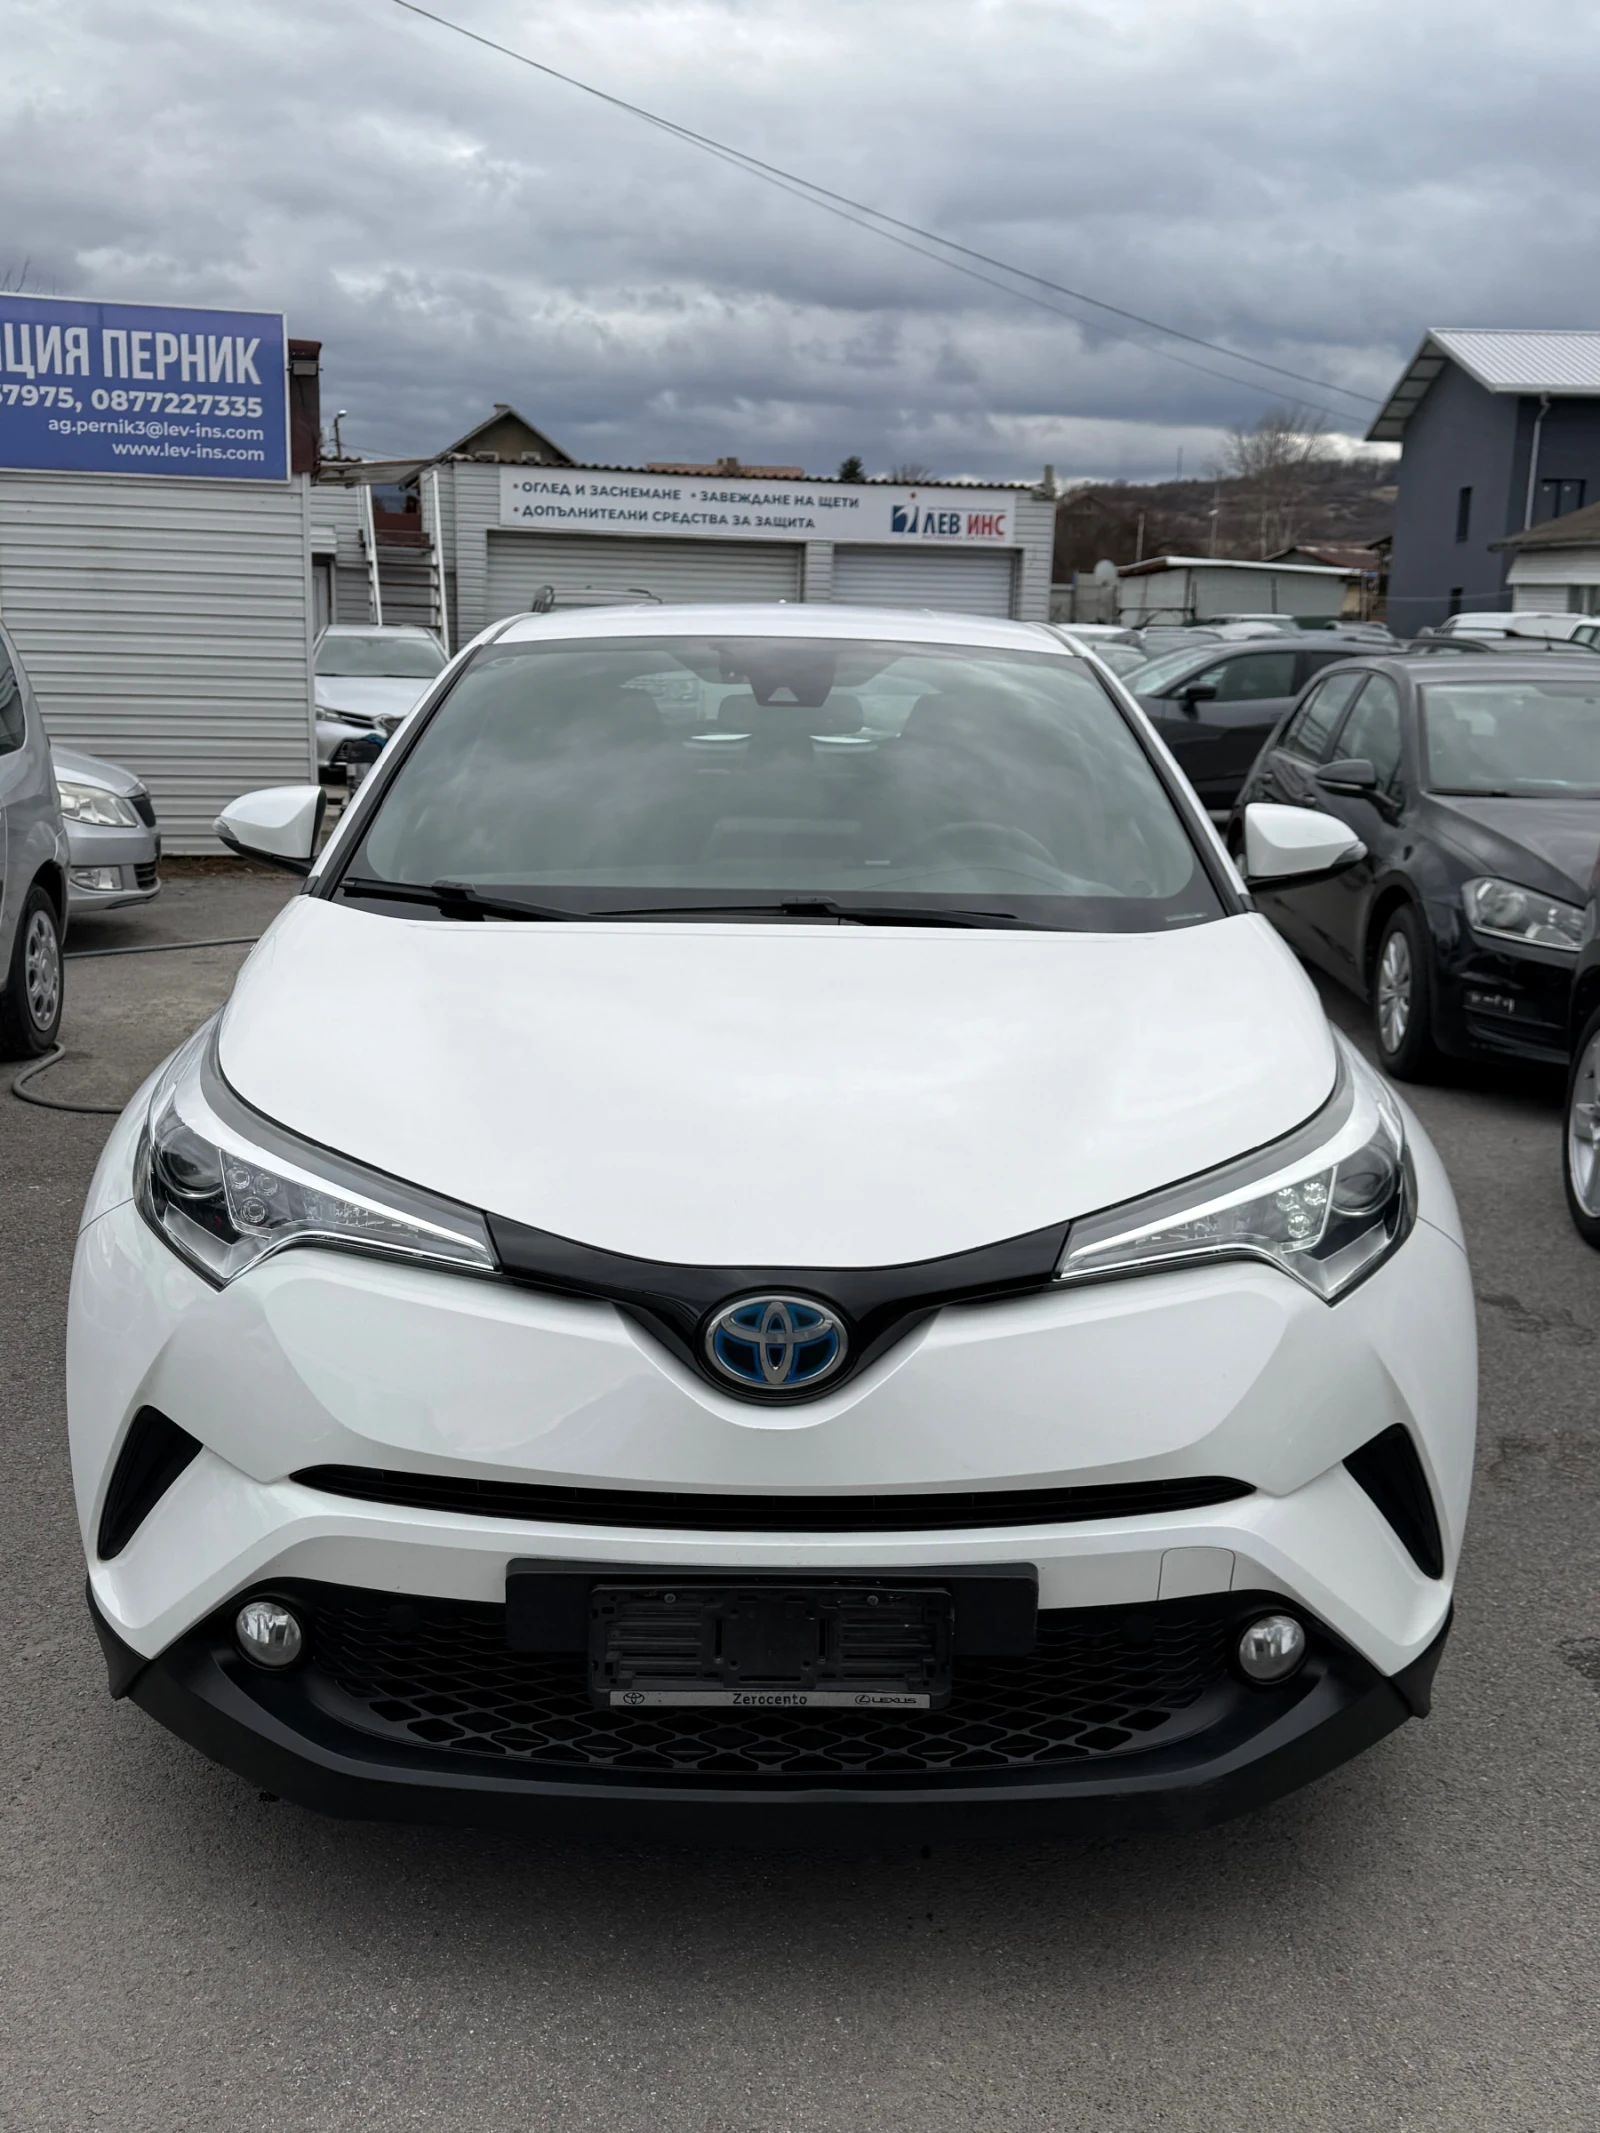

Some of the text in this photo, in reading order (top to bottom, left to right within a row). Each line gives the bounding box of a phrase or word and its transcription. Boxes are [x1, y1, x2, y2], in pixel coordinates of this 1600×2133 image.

[0, 322, 262, 385] ЦИЯ ПЕРНИК
[0, 383, 263, 418] 7975, 0877227335
[48, 418, 264, 440] ag.pernik3@lev-ins.com
[112, 442, 265, 461] www.lev-ins.com
[521, 482, 682, 500] ОГЛЕД И ЗАСНЕМАНЕ
[700, 490, 860, 509] ЗАВЕЖДАНЕ НА ЩЕТИ
[521, 504, 816, 529] ДОПЪЛНИТЕЛНИ СРЕДСТВА ЗА ЗАЩИТА
[922, 512, 1007, 536] ЛЕВ ИНС
[732, 1691, 918, 1706] Zerocento LEXUS
